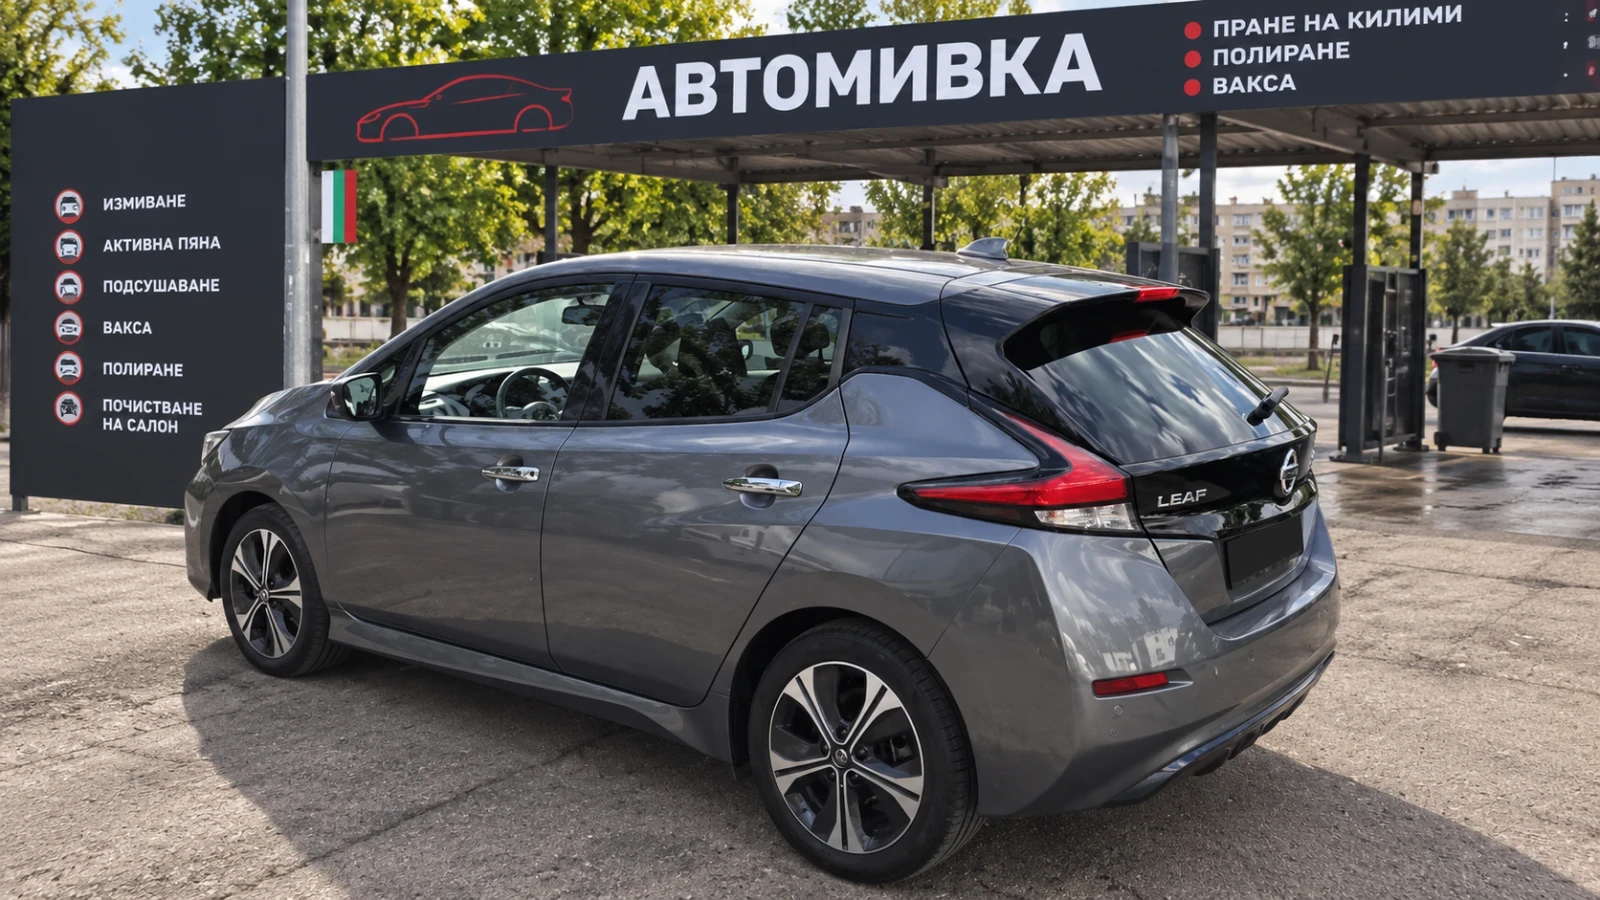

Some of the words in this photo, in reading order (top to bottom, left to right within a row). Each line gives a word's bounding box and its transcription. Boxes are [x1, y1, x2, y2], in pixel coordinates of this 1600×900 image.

[1213, 15, 1296, 38] ПРАНЕ
[1304, 12, 1340, 32] НА
[1347, 4, 1463, 30] КИЛИМИ
[1213, 40, 1350, 67] ПОЛИРАНЕ
[622, 33, 1103, 121] АВТОМИВКА
[1212, 73, 1297, 95] ВАКСА
[103, 193, 187, 211] ИЗМИВАНЕ
[102, 237, 174, 253] АКТИВНА
[178, 235, 222, 251] ПЯНА
[103, 278, 220, 295] ПОДСУШАВАНЕ
[103, 320, 153, 335] ВАКСА
[102, 361, 184, 377] ПОЛИРАНЕ
[102, 398, 203, 416] ПОЧИСТВАНЕ
[102, 417, 124, 431] НА
[126, 418, 179, 434] САЛОН
[1157, 488, 1207, 507] LEAF
